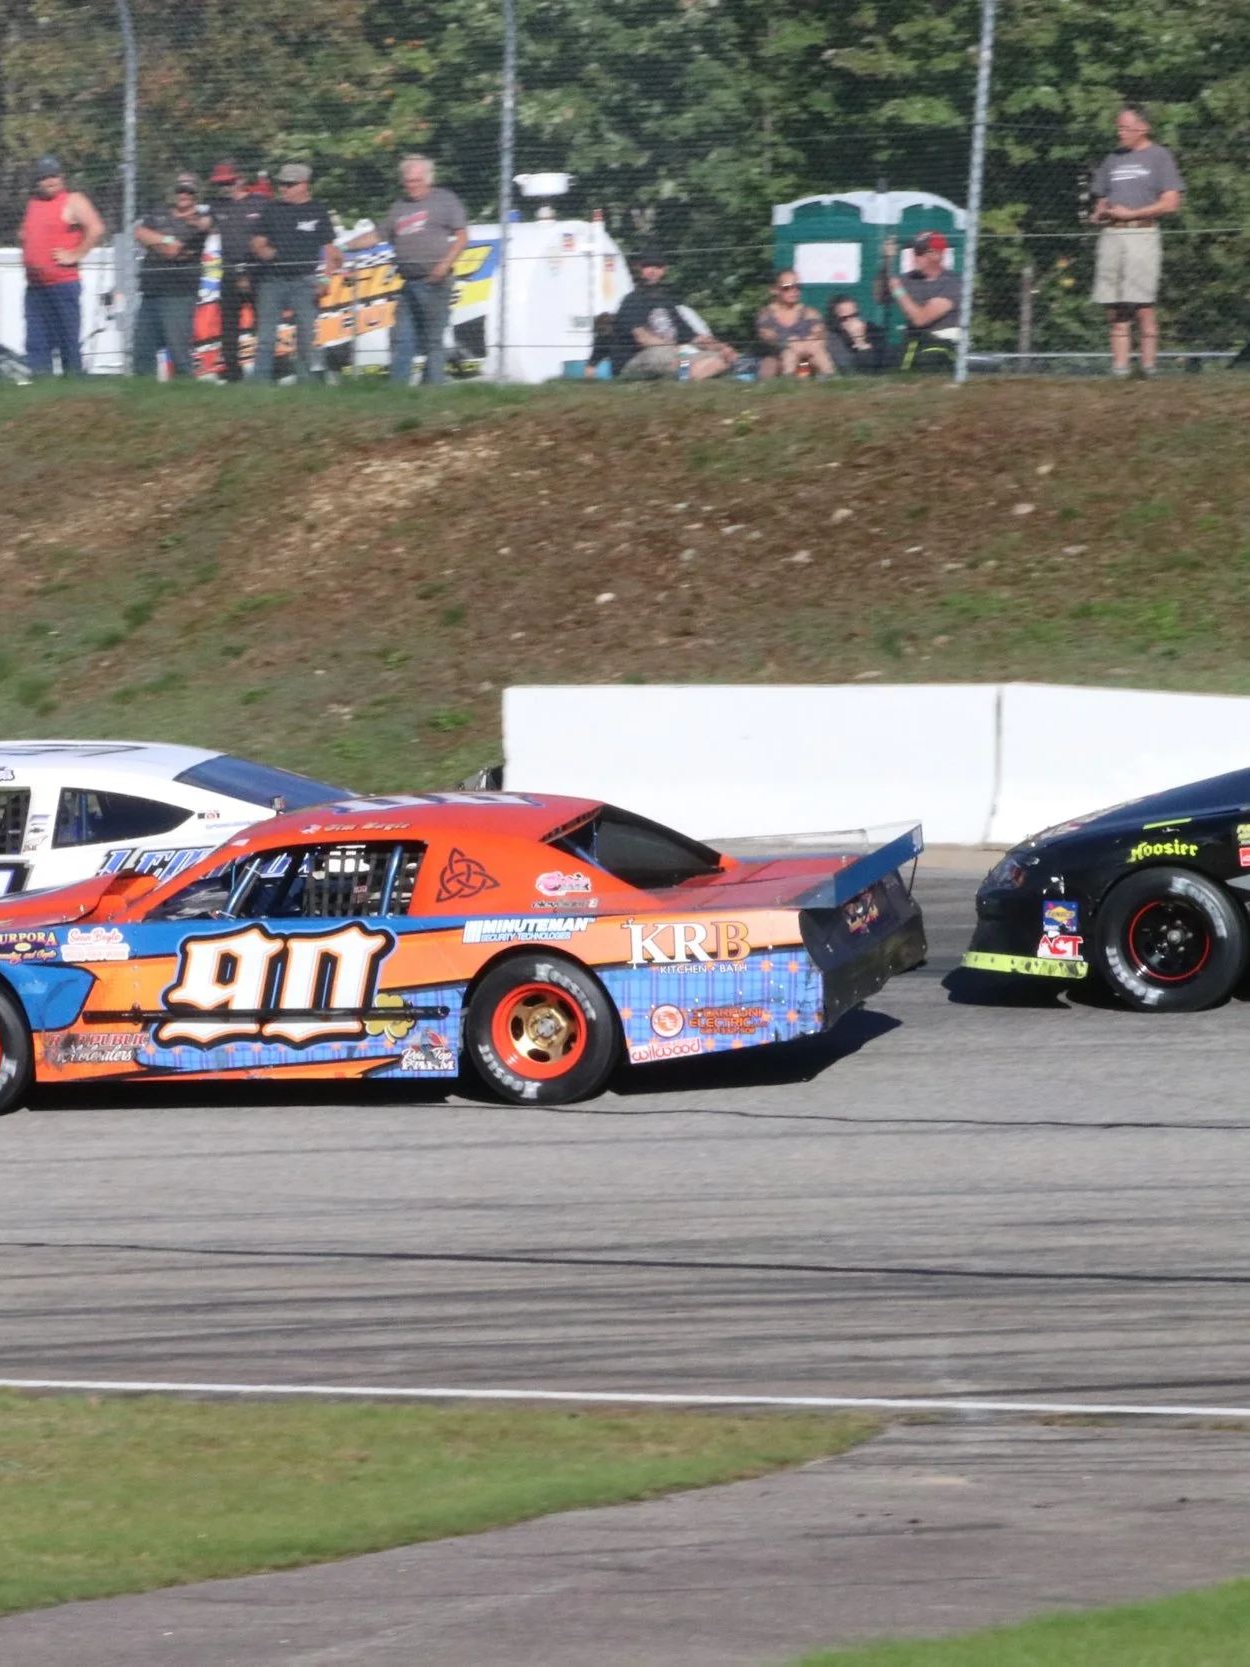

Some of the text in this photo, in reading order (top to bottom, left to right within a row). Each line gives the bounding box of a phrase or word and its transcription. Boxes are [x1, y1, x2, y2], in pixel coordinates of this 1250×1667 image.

[1125, 839, 1199, 864] Hoosier
[481, 918, 590, 933] MINUTEMAN
[481, 932, 516, 942] SECURITY
[621, 918, 751, 969] KRB
[660, 965, 707, 974] KITCHEN
[719, 964, 748, 973] BATH
[688, 1017, 751, 1028] ELECTRIC
[48, 1032, 150, 1046] RPUBLIC
[631, 1038, 701, 1062] wilwood
